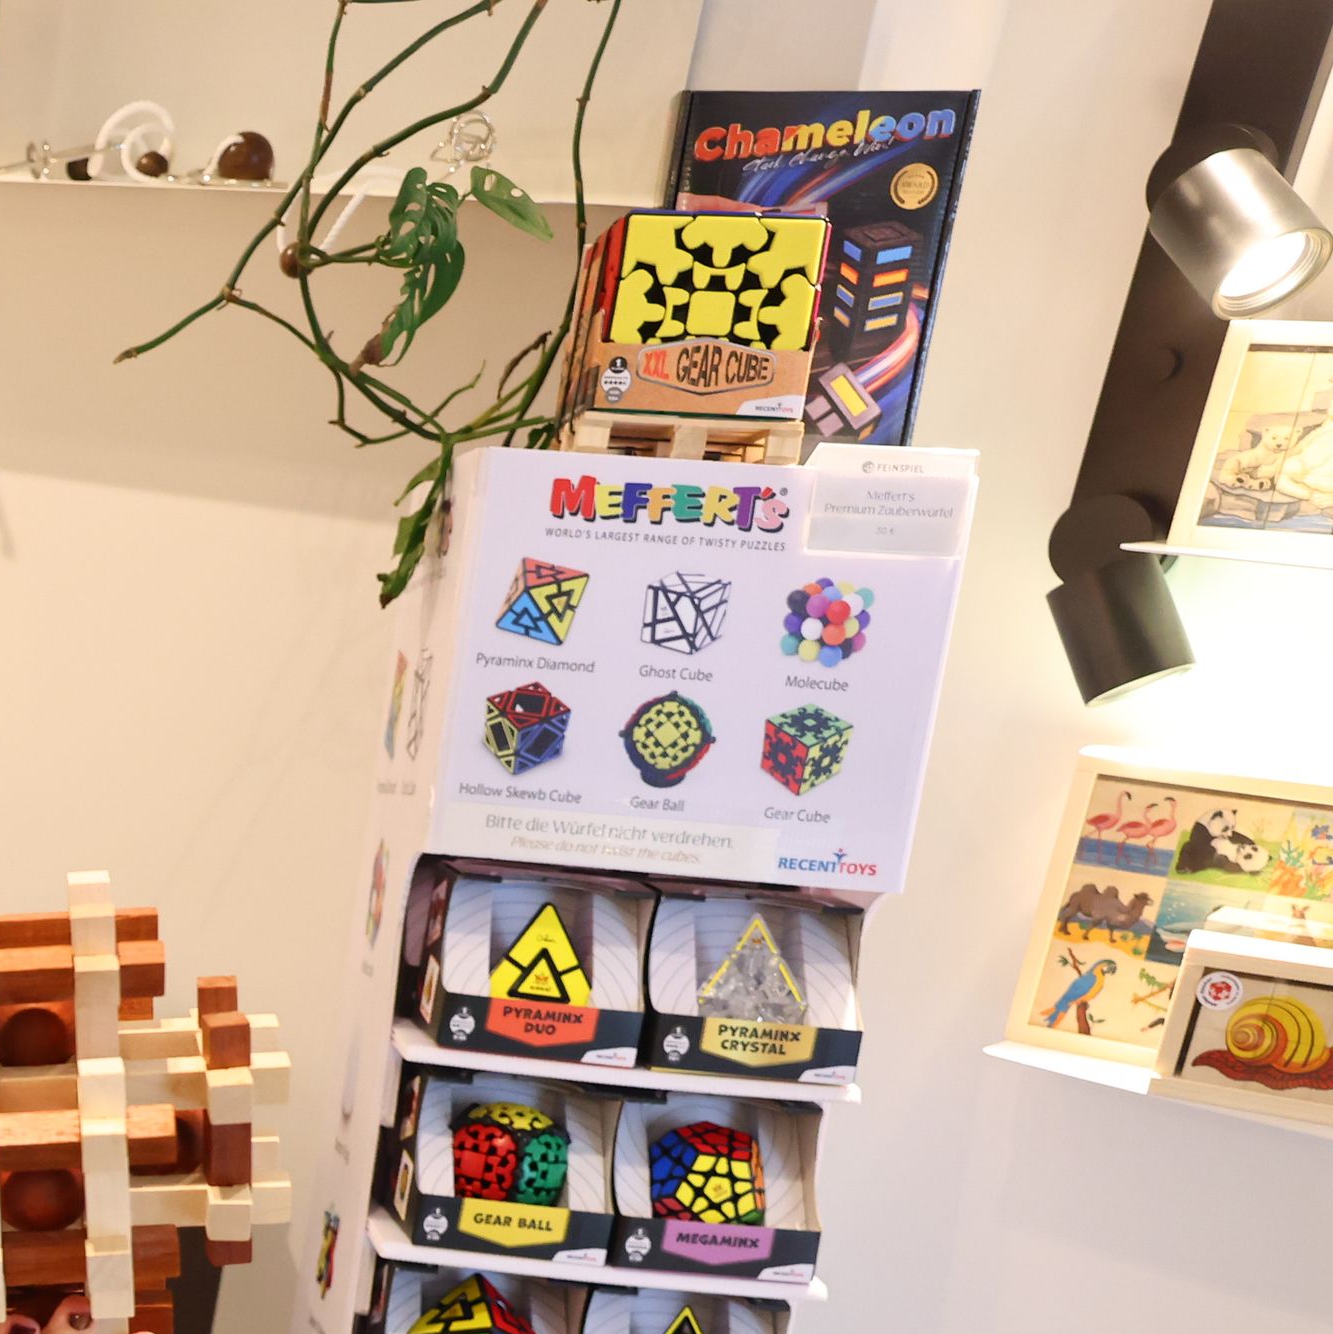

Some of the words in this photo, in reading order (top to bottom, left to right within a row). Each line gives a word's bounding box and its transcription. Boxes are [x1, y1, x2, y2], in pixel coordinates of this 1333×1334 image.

[693, 109, 956, 162] Chameleon
[643, 350, 670, 381] XXL
[676, 344, 722, 387] GEAR
[725, 350, 770, 384] CUBE
[877, 463, 925, 474] FEINSPIEL
[824, 502, 876, 516] Premium
[545, 526, 591, 540] WORLD'S
[595, 531, 640, 544] LARGEST
[643, 534, 678, 546] RANGE
[682, 536, 695, 547] OF
[699, 537, 737, 549] TWISTY
[741, 540, 786, 552] PUZZLES
[476, 652, 533, 670] Pyraminx
[536, 656, 596, 674] Diamond
[639, 664, 676, 680] Ghost
[680, 667, 713, 683] Cube
[785, 675, 849, 692] Molecube
[459, 782, 502, 798] Hollow
[506, 785, 547, 801] Skewb
[549, 788, 582, 805] Cube
[629, 795, 659, 811] Gear
[662, 797, 685, 812] Ball
[763, 806, 793, 822] Gear
[796, 808, 831, 824] Cube
[485, 814, 523, 831] Bitte
[525, 816, 549, 832] die
[553, 819, 607, 839] Würfel
[608, 823, 648, 842] nicht
[510, 835, 554, 852] Please
[556, 839, 571, 852] do
[575, 841, 599, 854] not
[637, 846, 658, 860] the
[503, 1005, 584, 1024] PYRAMINX
[524, 1023, 556, 1036] DUO
[718, 1024, 802, 1043] PYRAMINX
[720, 1039, 787, 1056] CRYSTAL
[473, 1213, 513, 1227] GEAR
[518, 1217, 553, 1232] BALL
[676, 1232, 761, 1249] MEGAMINX
